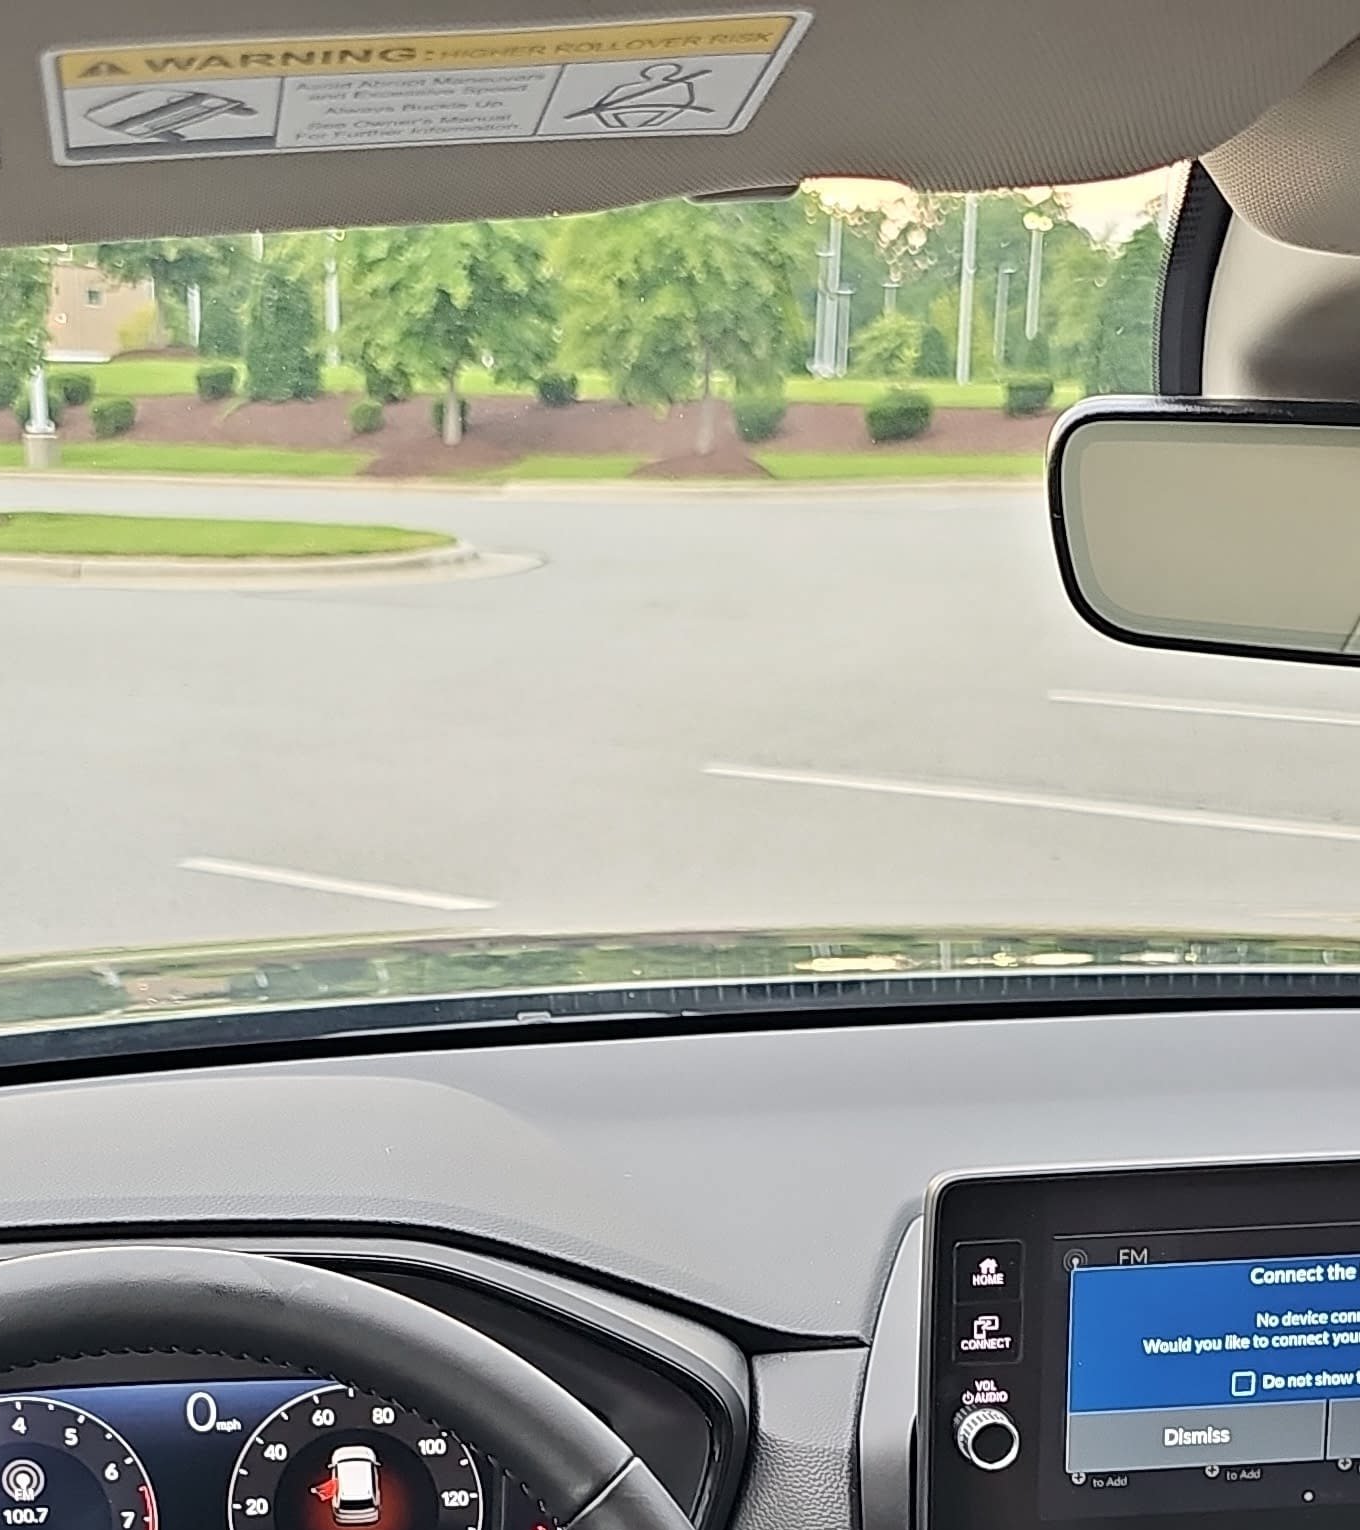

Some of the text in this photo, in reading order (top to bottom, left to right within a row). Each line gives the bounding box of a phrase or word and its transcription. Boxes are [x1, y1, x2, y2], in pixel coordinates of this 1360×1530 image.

[143, 47, 433, 73] WARNING:
[708, 31, 774, 45] RISK
[1119, 1249, 1149, 1266] FM
[972, 1273, 1005, 1287] HOME
[1250, 1265, 1324, 1286] Connect
[1326, 1262, 1357, 1282] the
[1256, 1312, 1279, 1328] No
[1281, 1309, 1328, 1327] device
[960, 1337, 1012, 1351] CONNECT
[1142, 1335, 1192, 1355] Would
[1194, 1338, 1222, 1355] you
[1224, 1334, 1251, 1351] like
[1253, 1334, 1269, 1349] to
[1271, 1331, 1330, 1348] connect
[974, 1379, 998, 1392] VOL
[1262, 1373, 1285, 1389] Do
[1287, 1372, 1313, 1388] not
[1314, 1369, 1354, 1386] show
[974, 1391, 1009, 1404] AUDIO
[186, 1391, 242, 1433] 0 mph
[311, 1410, 335, 1427] 60
[371, 1407, 395, 1425] 80
[11, 1416, 27, 1435] 4
[64, 1428, 79, 1447] 5
[1164, 1426, 1231, 1447] Dismiss
[263, 1444, 287, 1461] 40
[417, 1439, 446, 1456] 100
[104, 1462, 120, 1481] 6
[1226, 1469, 1261, 1481] to Add
[1093, 1475, 1128, 1488] to Add
[13, 1488, 36, 1502] FM
[441, 1490, 469, 1508] 120
[245, 1498, 269, 1516] 20
[2, 1508, 49, 1525] 100.7
[120, 1511, 135, 1529] 7
